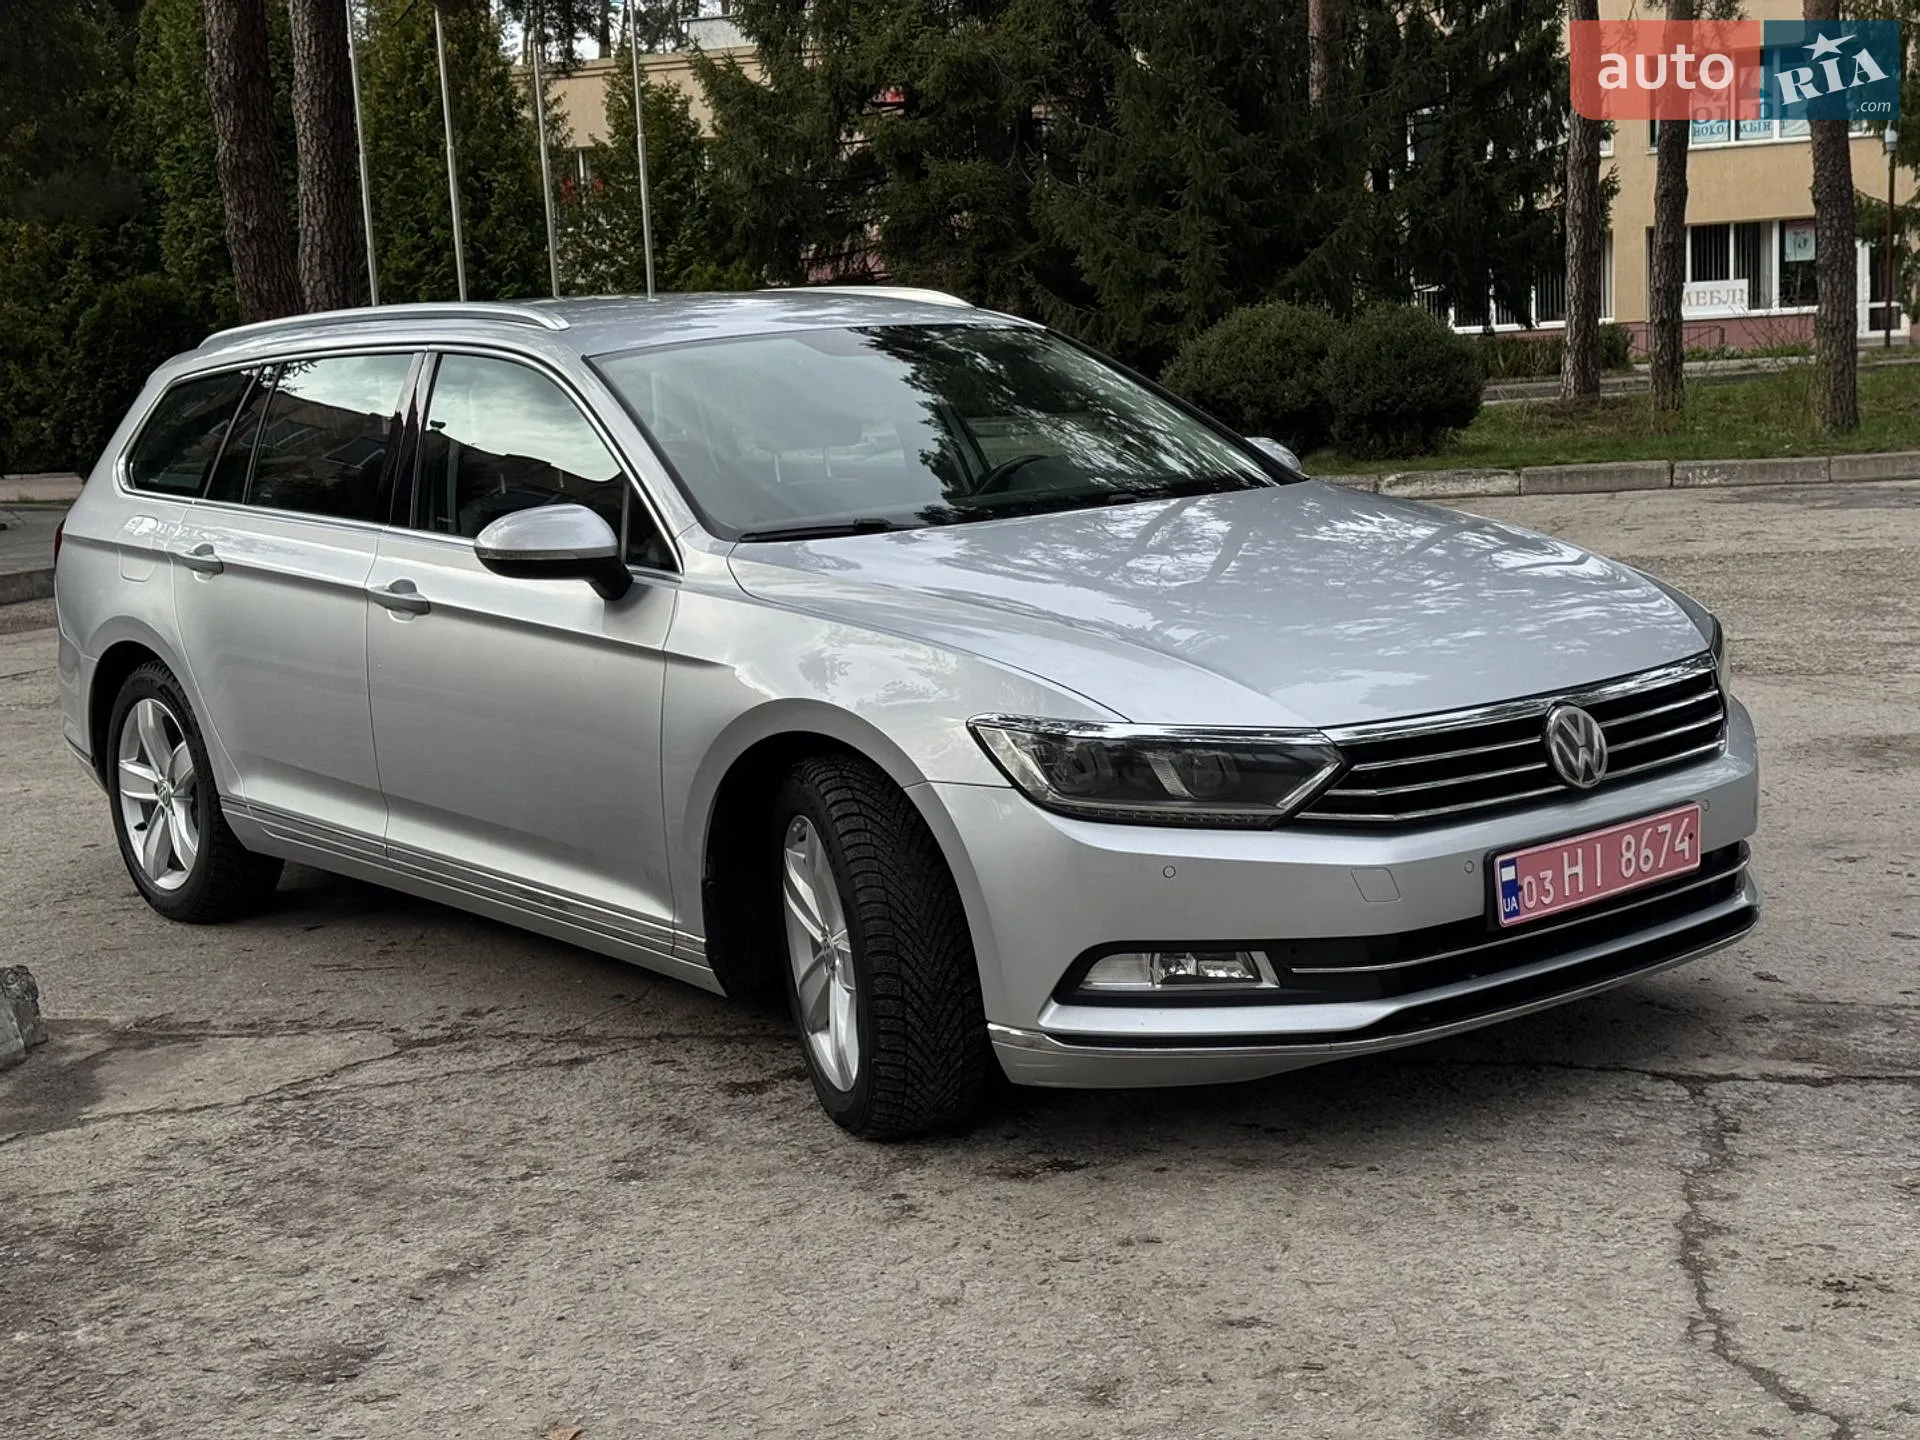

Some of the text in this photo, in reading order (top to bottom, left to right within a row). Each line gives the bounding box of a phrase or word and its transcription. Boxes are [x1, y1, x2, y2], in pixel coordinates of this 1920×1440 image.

[1521, 869, 1555, 909] 03
[1620, 817, 1690, 879] 8674
[1502, 896, 1519, 913] UA
